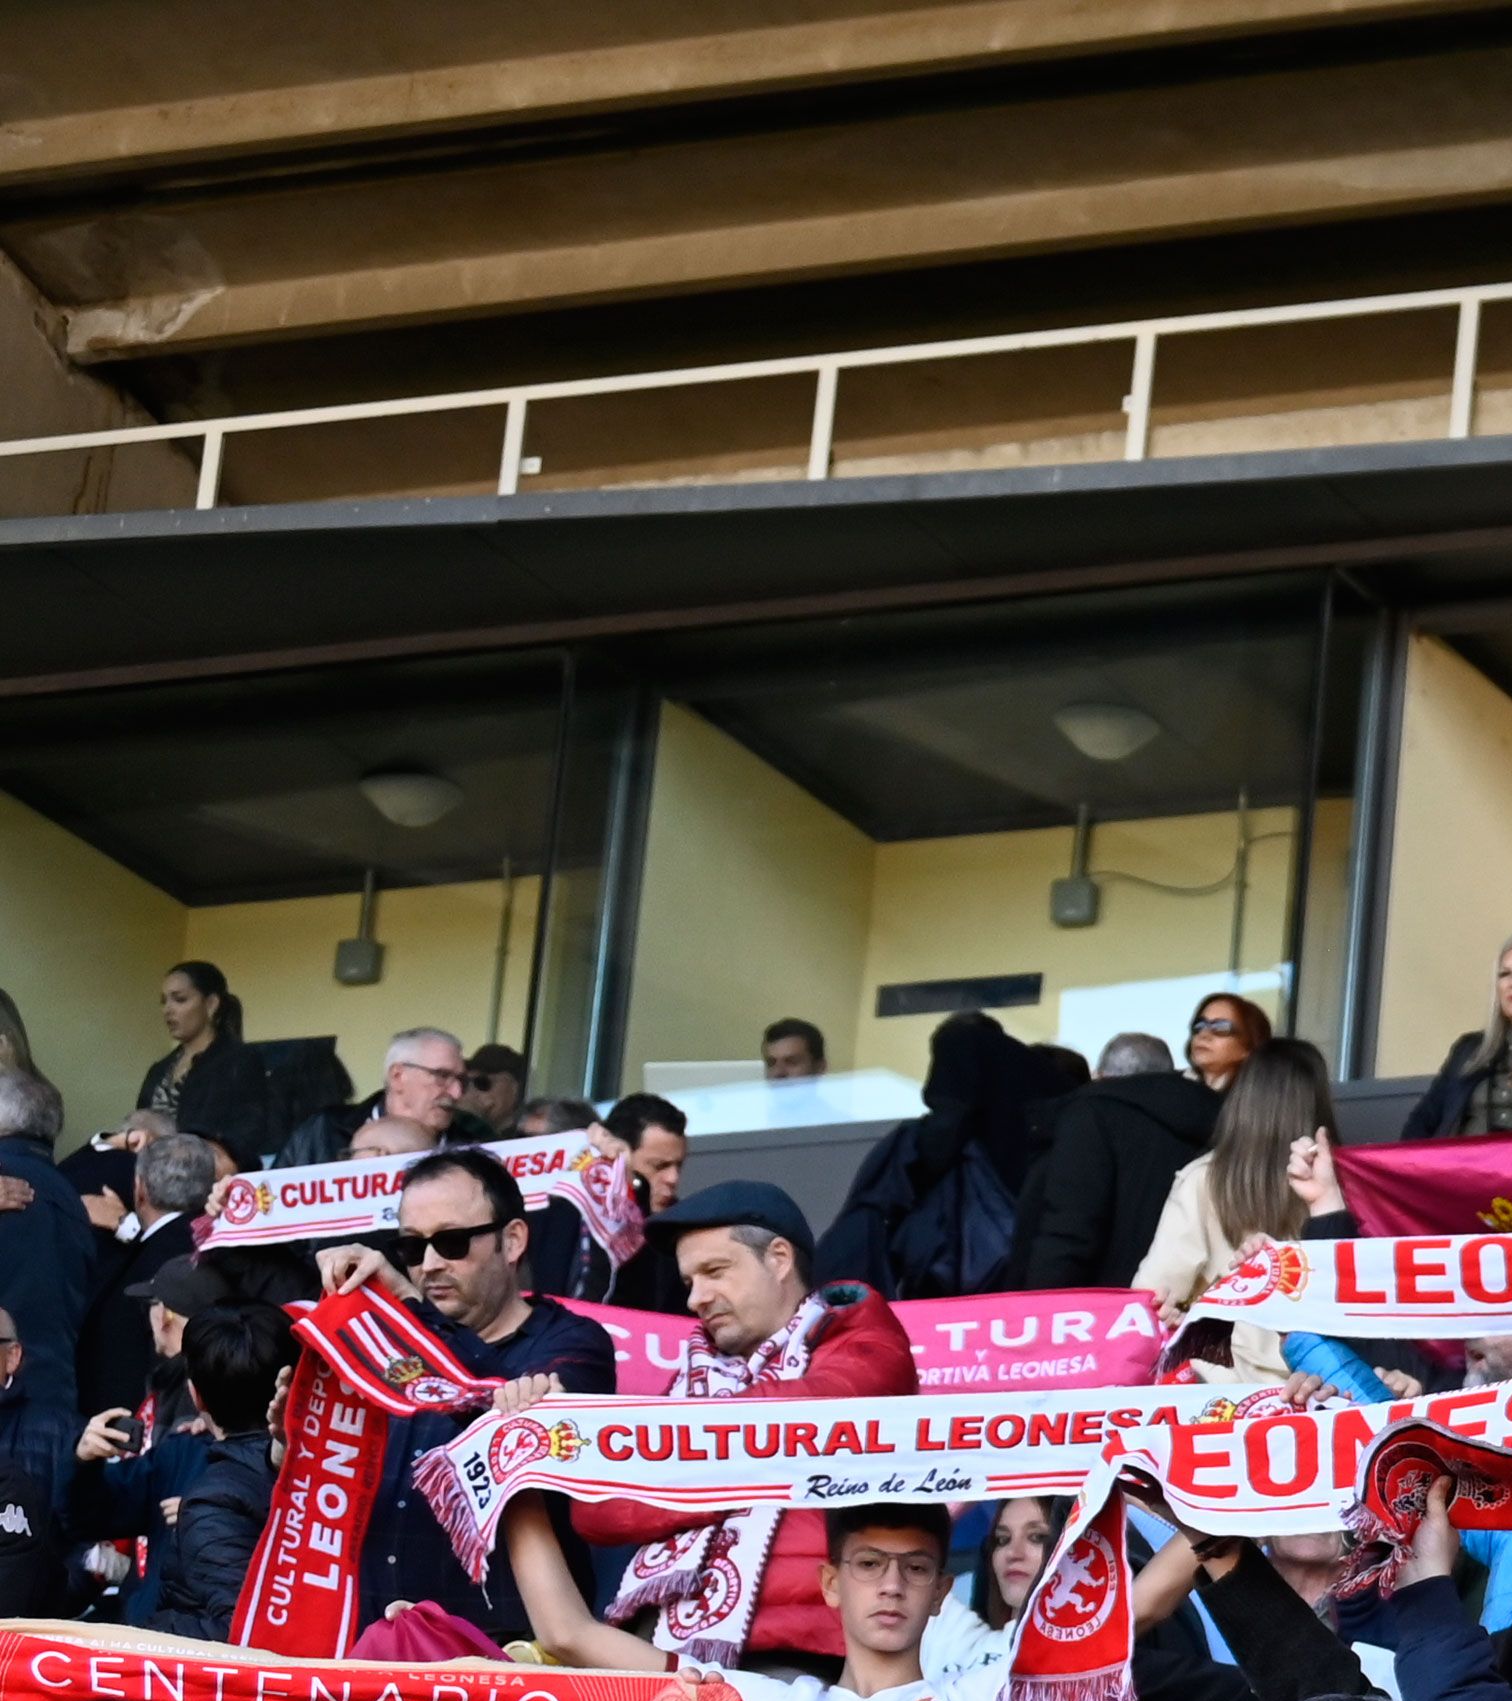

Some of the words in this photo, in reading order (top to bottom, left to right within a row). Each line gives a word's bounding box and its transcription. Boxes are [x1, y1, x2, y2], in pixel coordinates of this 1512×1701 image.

[280, 1170, 404, 1210] CULTURA
[512, 1148, 566, 1178] NESA
[917, 1364, 994, 1387] ORTIVA
[996, 1357, 1098, 1382] LEONESA
[596, 1418, 896, 1463] CULTURAL
[303, 1382, 367, 1593] LEONE
[461, 1450, 494, 1512] 1923
[803, 1474, 870, 1501] Reino
[877, 1471, 907, 1496] de
[912, 1466, 973, 1494] León
[266, 1473, 312, 1627] CULTURAL
[295, 1441, 317, 1460] Y
[135, 1640, 217, 1661] CULTURAL
[408, 1672, 527, 1688] LEONESA
